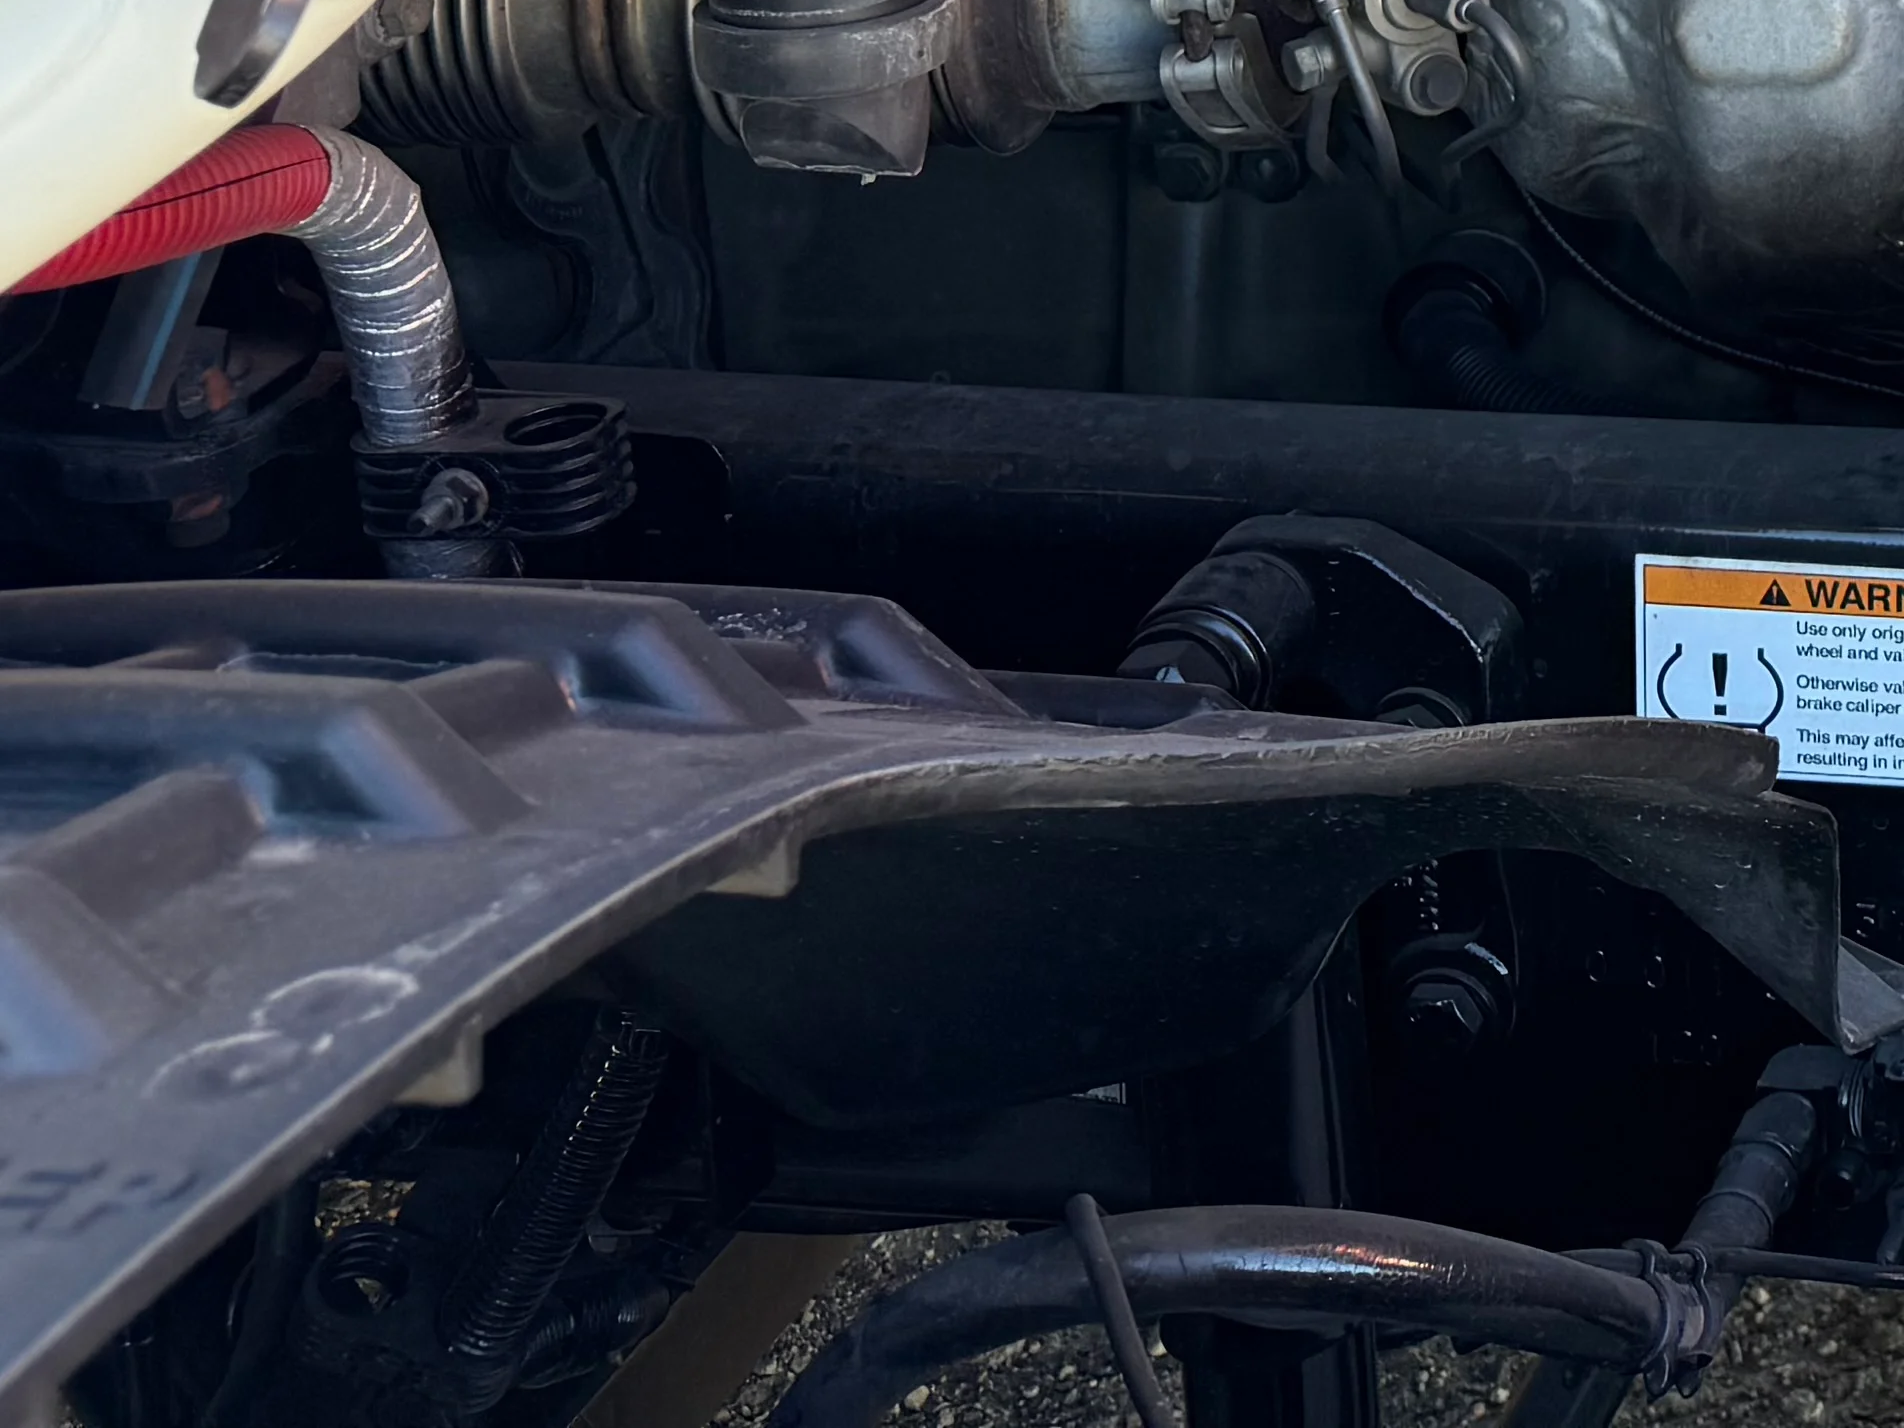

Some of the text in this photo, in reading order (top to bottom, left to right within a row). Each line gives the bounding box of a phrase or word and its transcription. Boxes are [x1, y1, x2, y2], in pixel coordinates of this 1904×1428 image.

[1796, 621, 1827, 637] Use
[1832, 624, 1867, 644] only
[1796, 643, 1843, 660] wheel
[1847, 646, 1878, 661] and
[1796, 674, 1878, 694] Otherwise
[1796, 695, 1842, 713] brake
[1846, 696, 1901, 716] caliper
[1796, 729, 1831, 746] This
[1835, 732, 1870, 750] may
[1796, 750, 1869, 770] resulting
[1872, 754, 1887, 769] in
